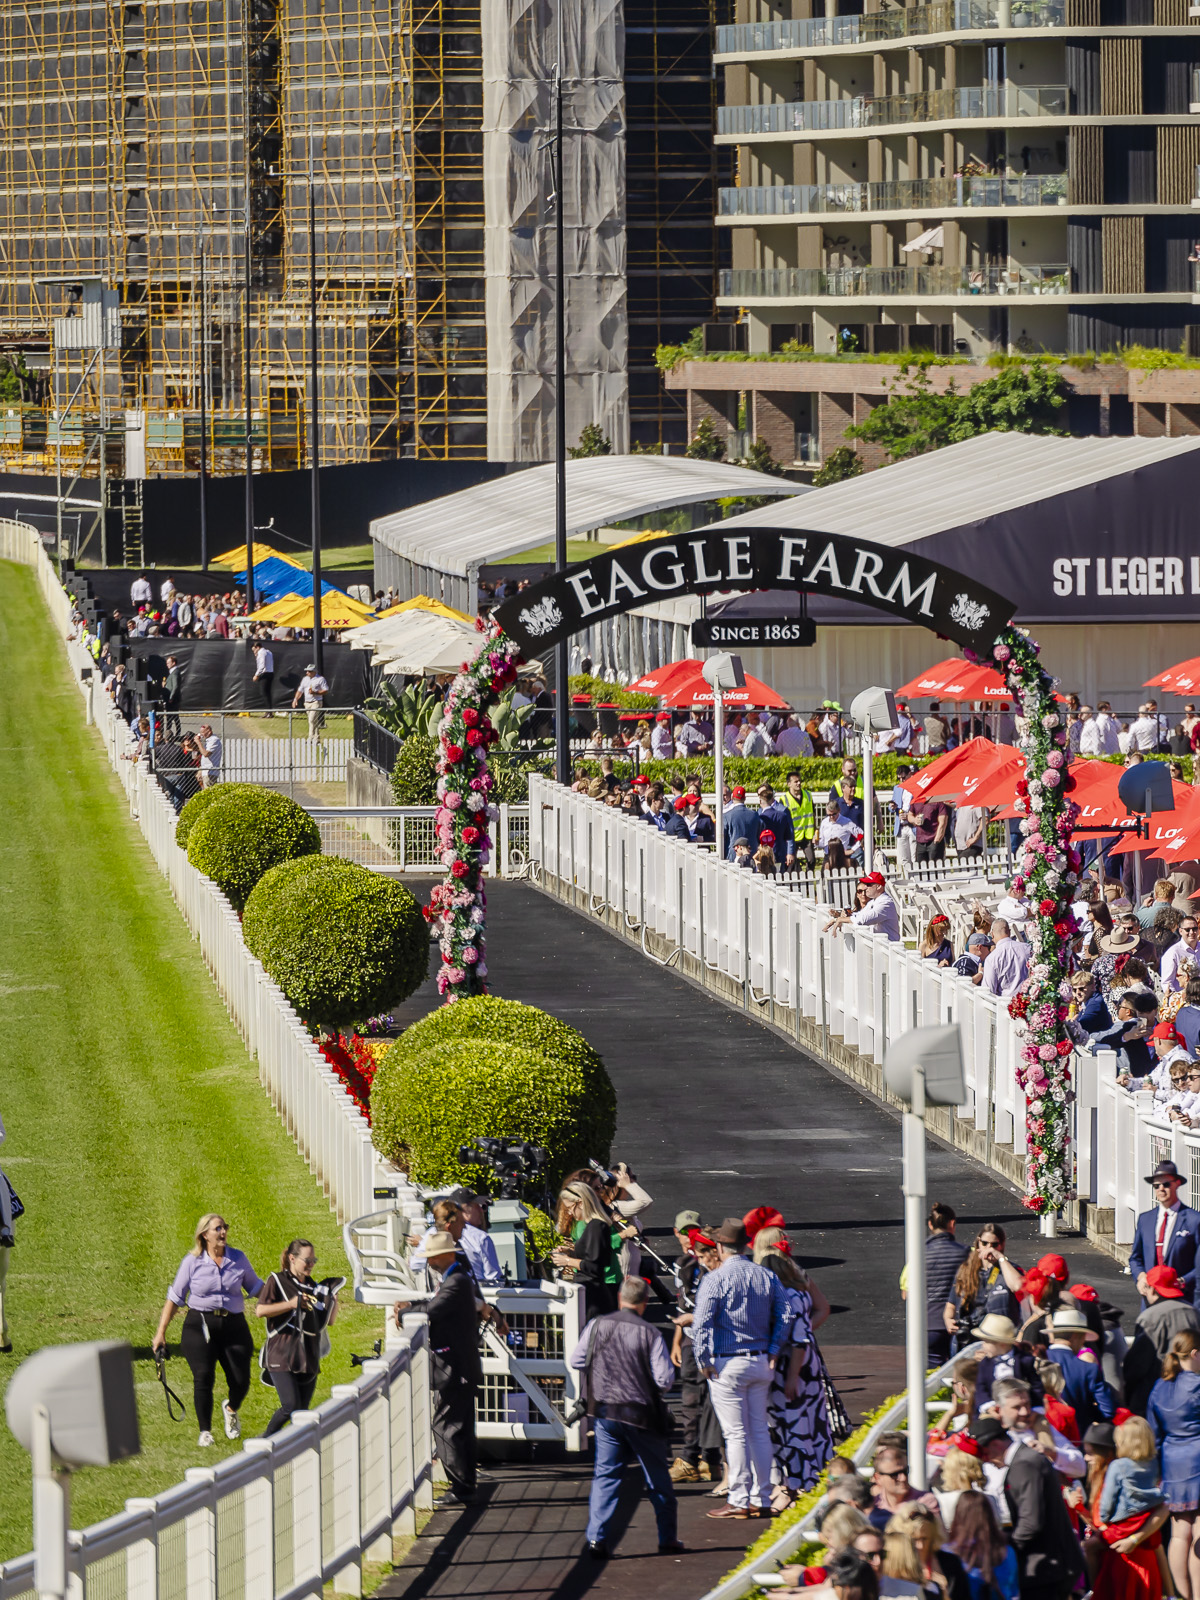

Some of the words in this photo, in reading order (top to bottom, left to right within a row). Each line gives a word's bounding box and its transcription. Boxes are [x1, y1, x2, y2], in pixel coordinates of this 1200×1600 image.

[565, 536, 754, 618] EAGLE
[776, 536, 938, 618] FARM
[1053, 558, 1091, 596] ST
[1097, 557, 1184, 595] LEGER
[711, 625, 760, 641] SINCE
[764, 625, 801, 640] 1865
